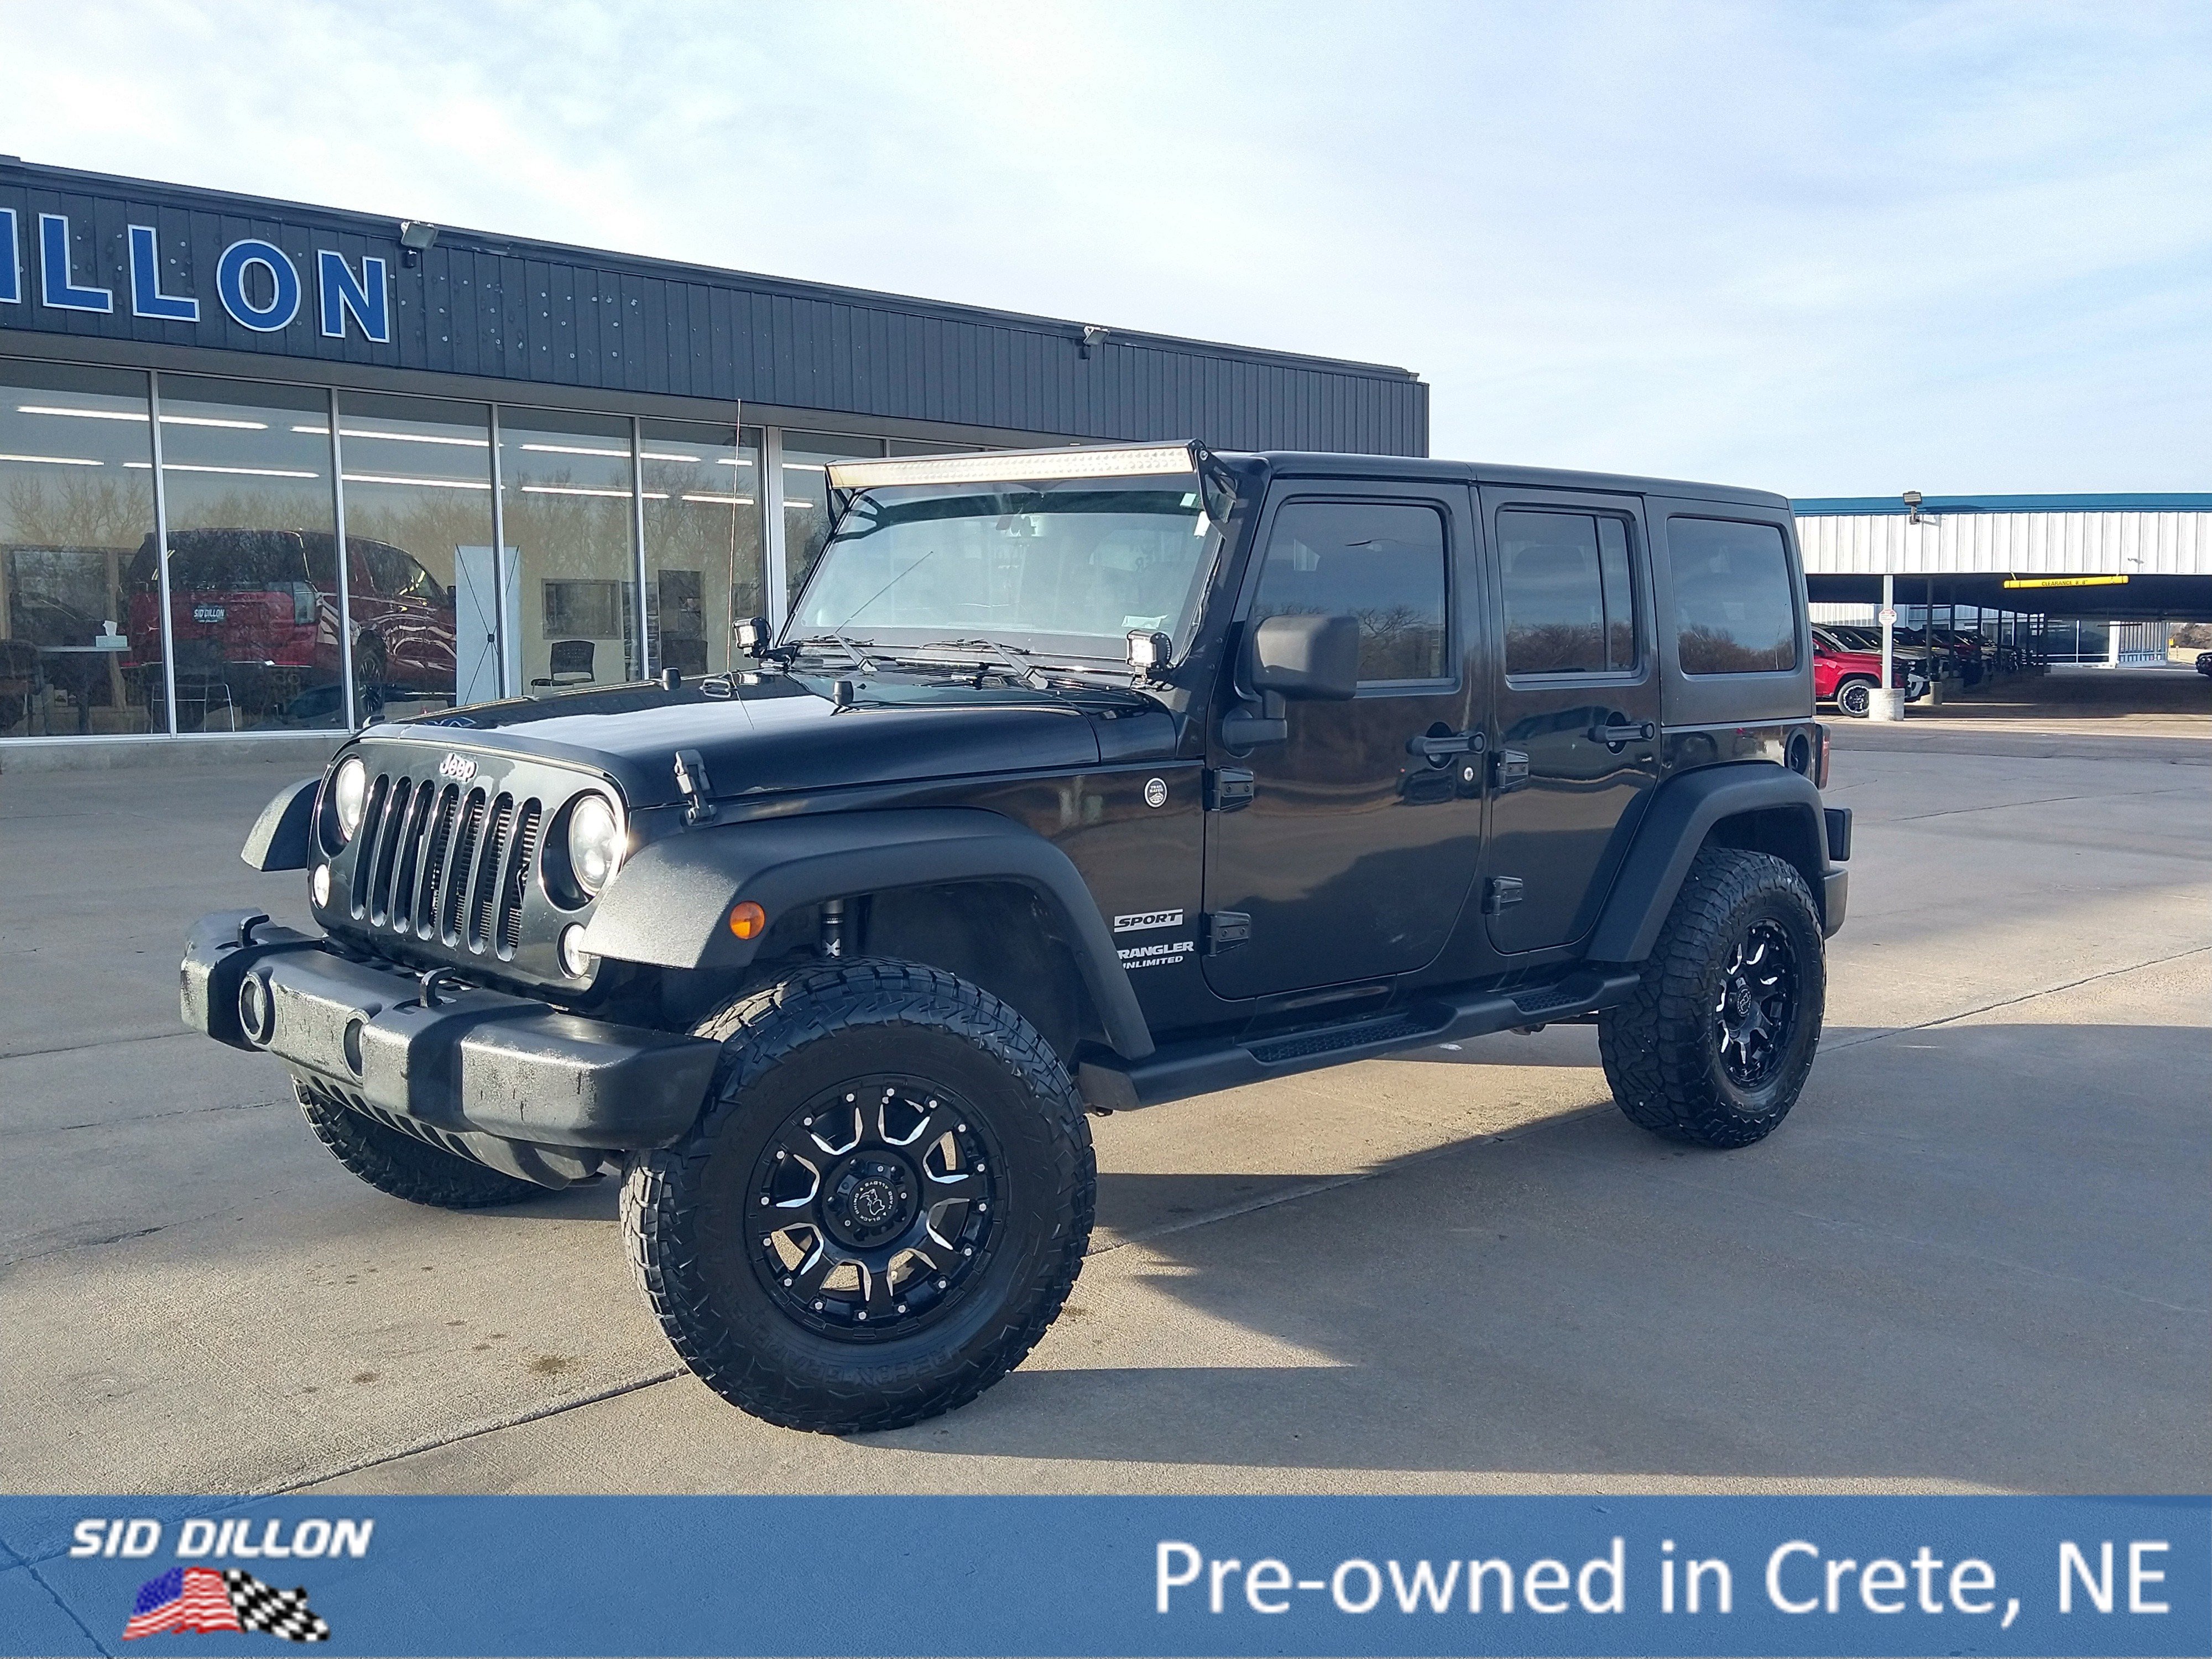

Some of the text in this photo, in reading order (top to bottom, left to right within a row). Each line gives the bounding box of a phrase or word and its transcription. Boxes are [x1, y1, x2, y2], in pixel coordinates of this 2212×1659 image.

[439, 753, 477, 782] Jeep
[1117, 912, 1182, 927] SPORT
[1117, 941, 1194, 959] RANGLER
